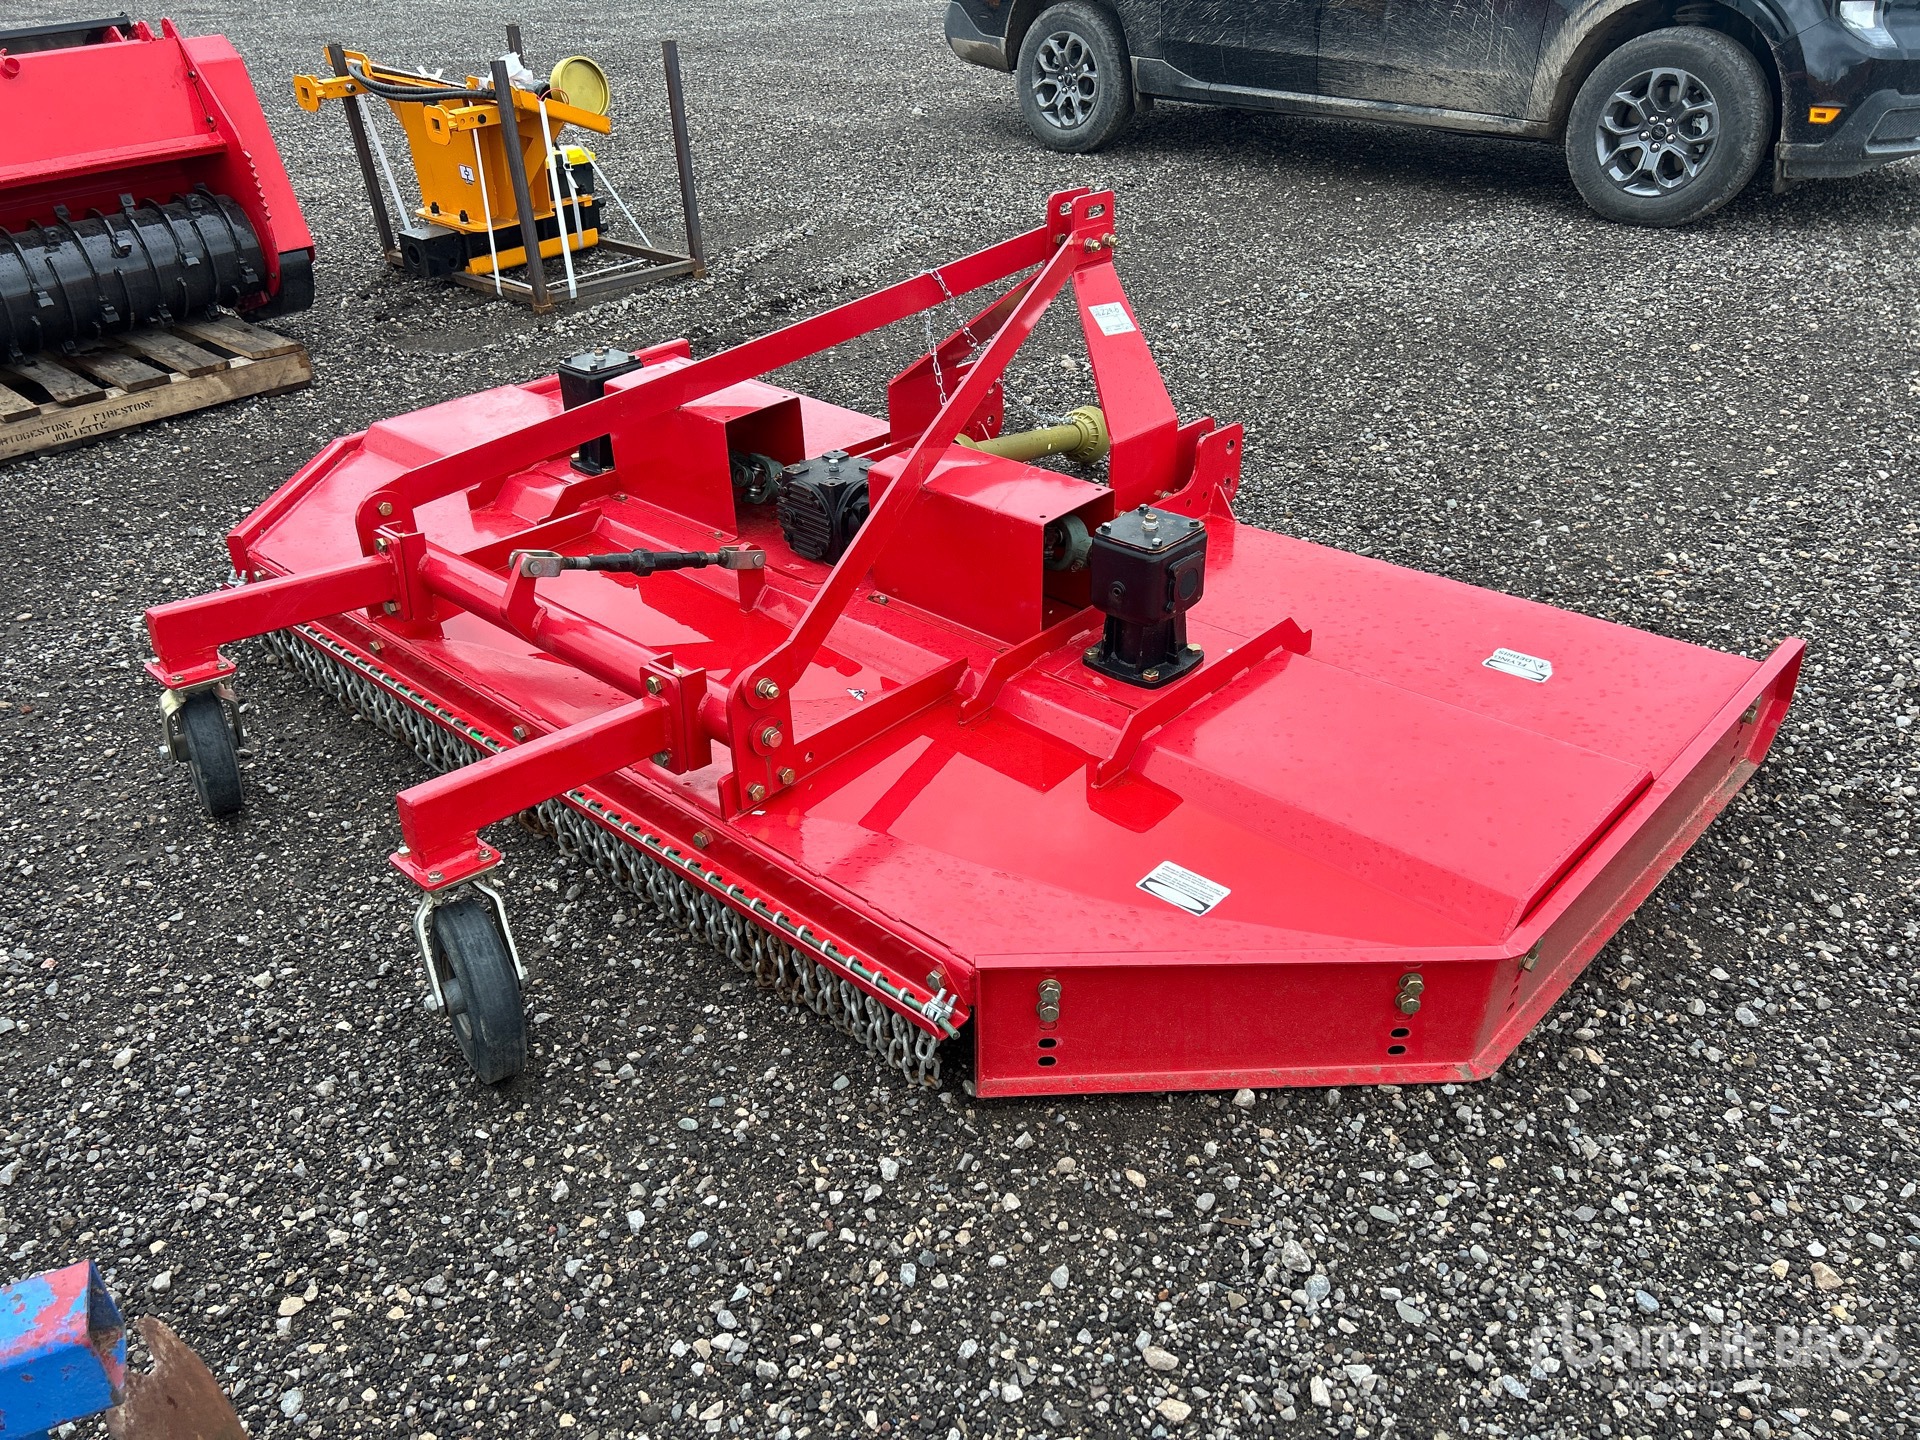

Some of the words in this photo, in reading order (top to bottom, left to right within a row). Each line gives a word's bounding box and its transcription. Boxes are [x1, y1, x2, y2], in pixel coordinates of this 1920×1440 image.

[93, 400, 154, 422] FIRESTONE
[52, 421, 108, 442] JOLIETTE
[1494, 654, 1527, 668] FLYING
[1498, 650, 1533, 663] DEBRIS
